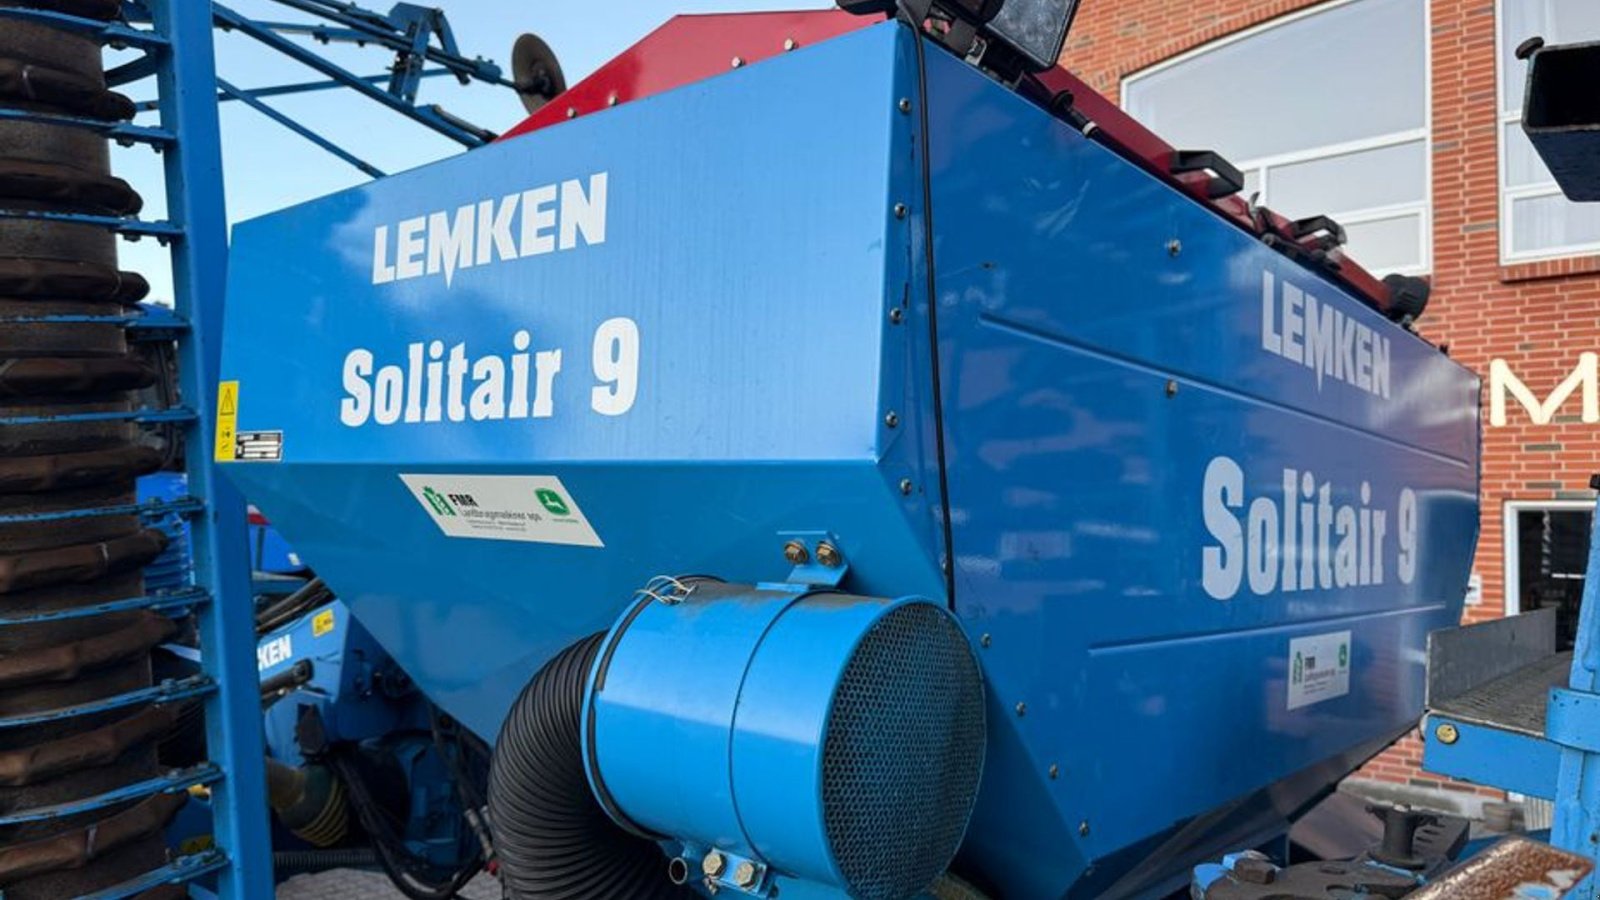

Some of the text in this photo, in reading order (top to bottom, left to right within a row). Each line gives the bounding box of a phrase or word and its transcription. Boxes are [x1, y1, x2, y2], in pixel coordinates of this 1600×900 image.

[372, 172, 608, 288] LEMKEN
[341, 317, 640, 427] Solitair 9
[1262, 269, 1391, 400] LEMKEN
[1489, 351, 1600, 427] M
[1202, 456, 1417, 600] Solitair 9
